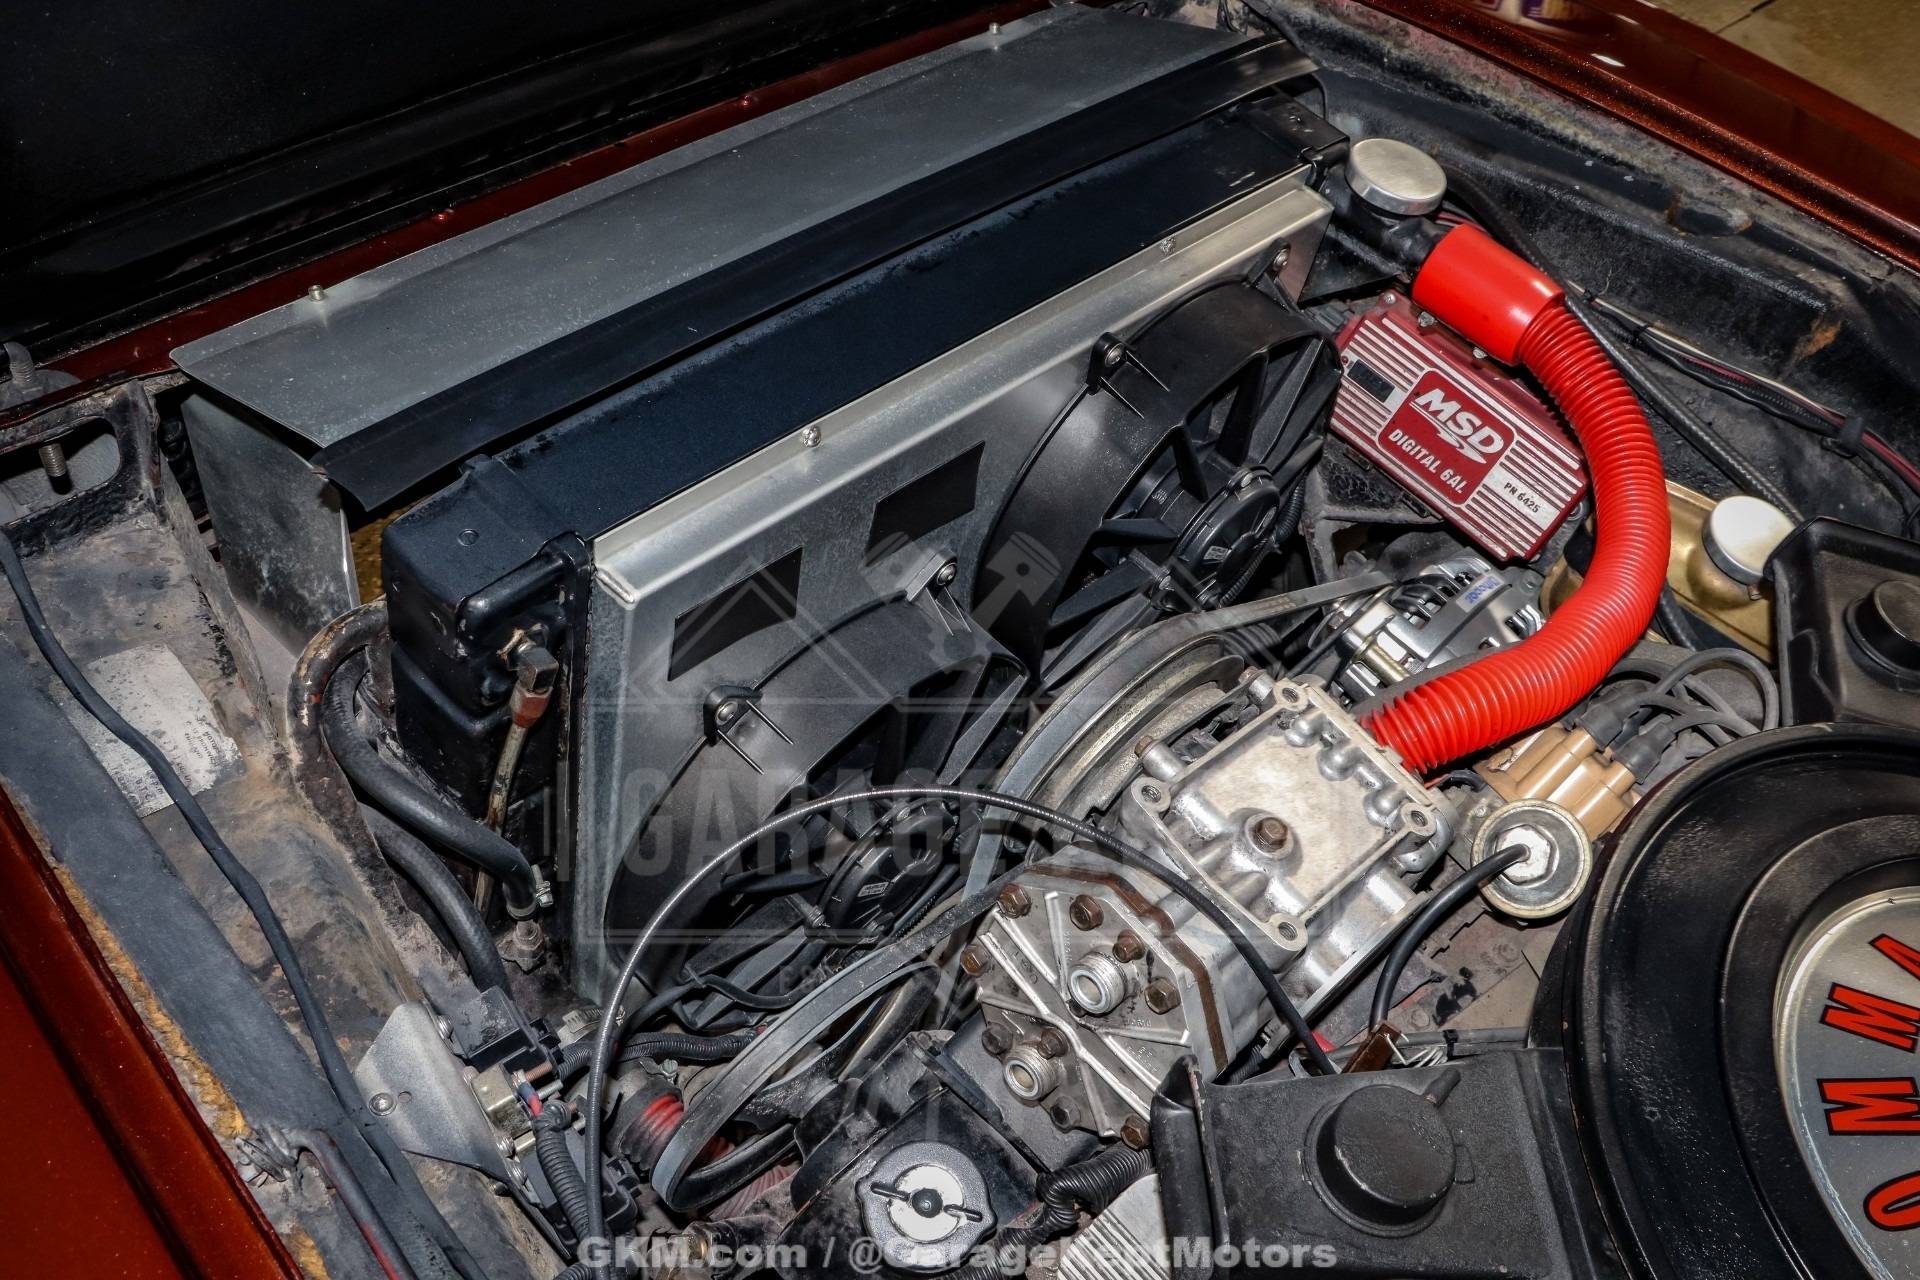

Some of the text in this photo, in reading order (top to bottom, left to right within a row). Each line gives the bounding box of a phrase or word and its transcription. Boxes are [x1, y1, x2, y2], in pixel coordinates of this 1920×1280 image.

[1415, 388, 1504, 454] MSD
[1388, 428, 1468, 494] DIGITAL 6AL
[1503, 482, 1542, 513] PN 6425
